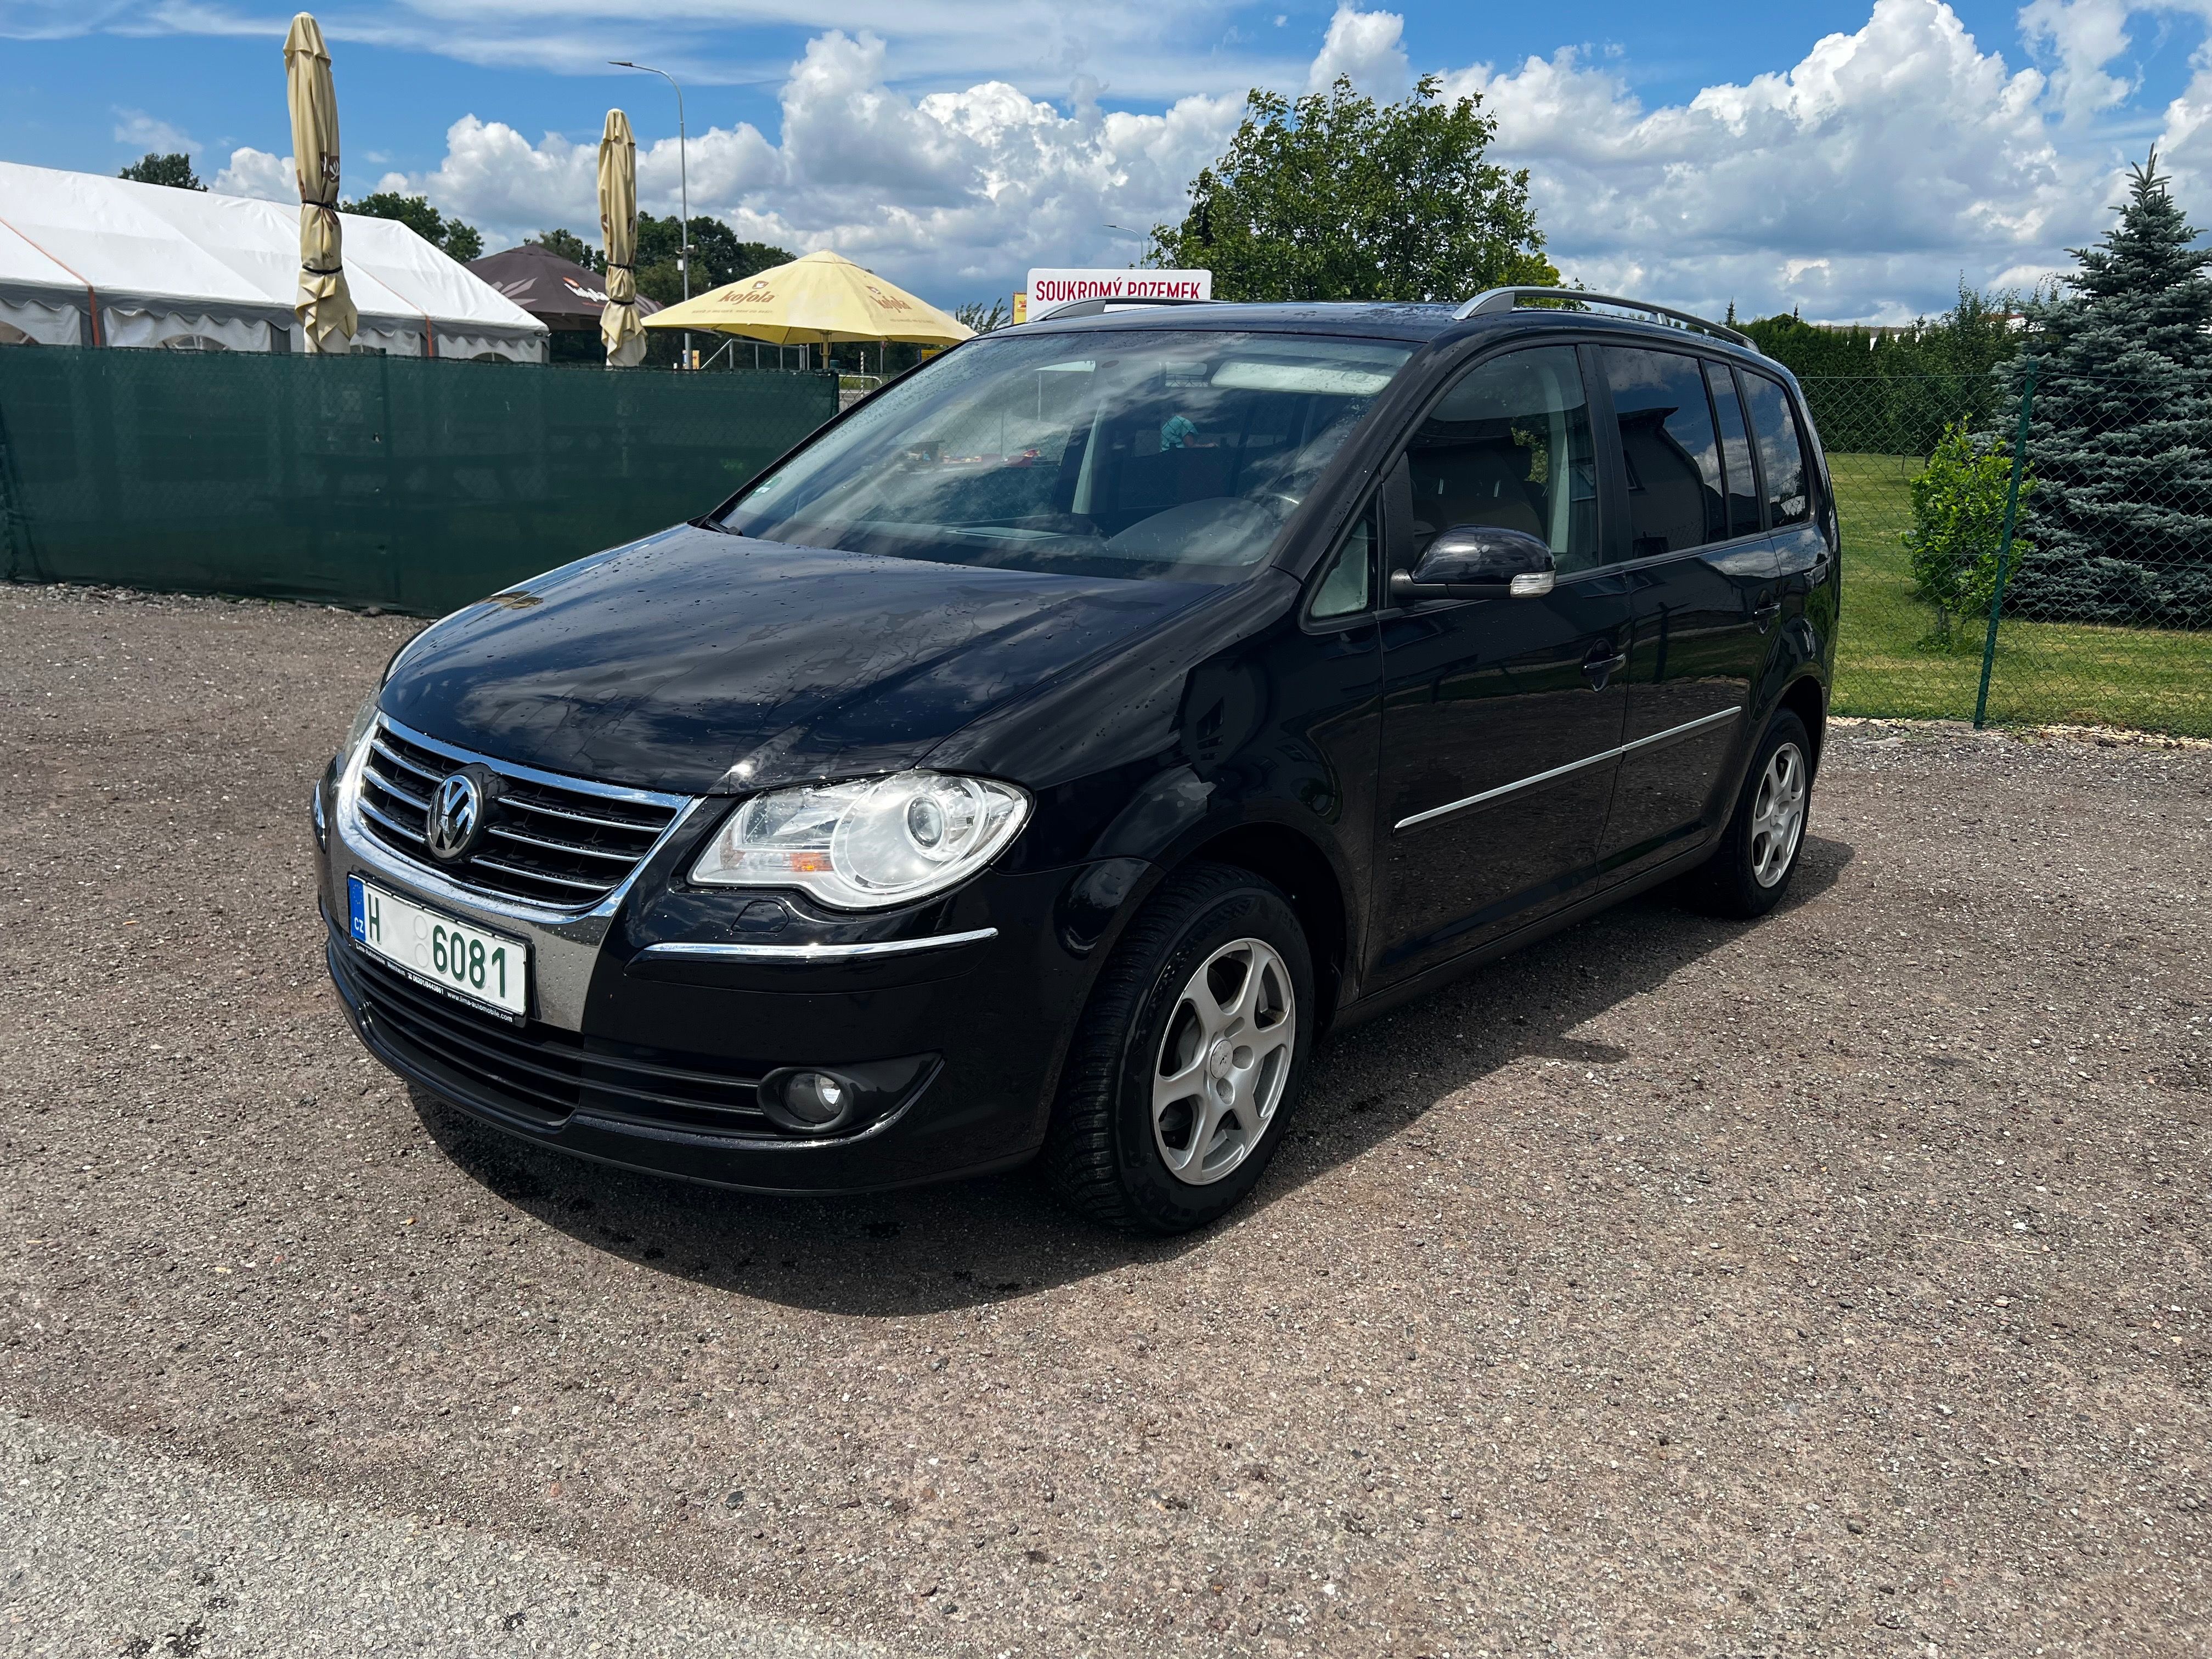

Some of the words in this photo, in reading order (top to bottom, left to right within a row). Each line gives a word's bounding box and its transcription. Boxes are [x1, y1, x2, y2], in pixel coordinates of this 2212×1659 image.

[718, 290, 776, 305] kofola
[1036, 276, 1122, 301] SOUKROMÝ
[1127, 281, 1201, 299] POZEMEK
[354, 917, 365, 934] CZ
[368, 893, 381, 943] H
[432, 924, 506, 998] 6081
